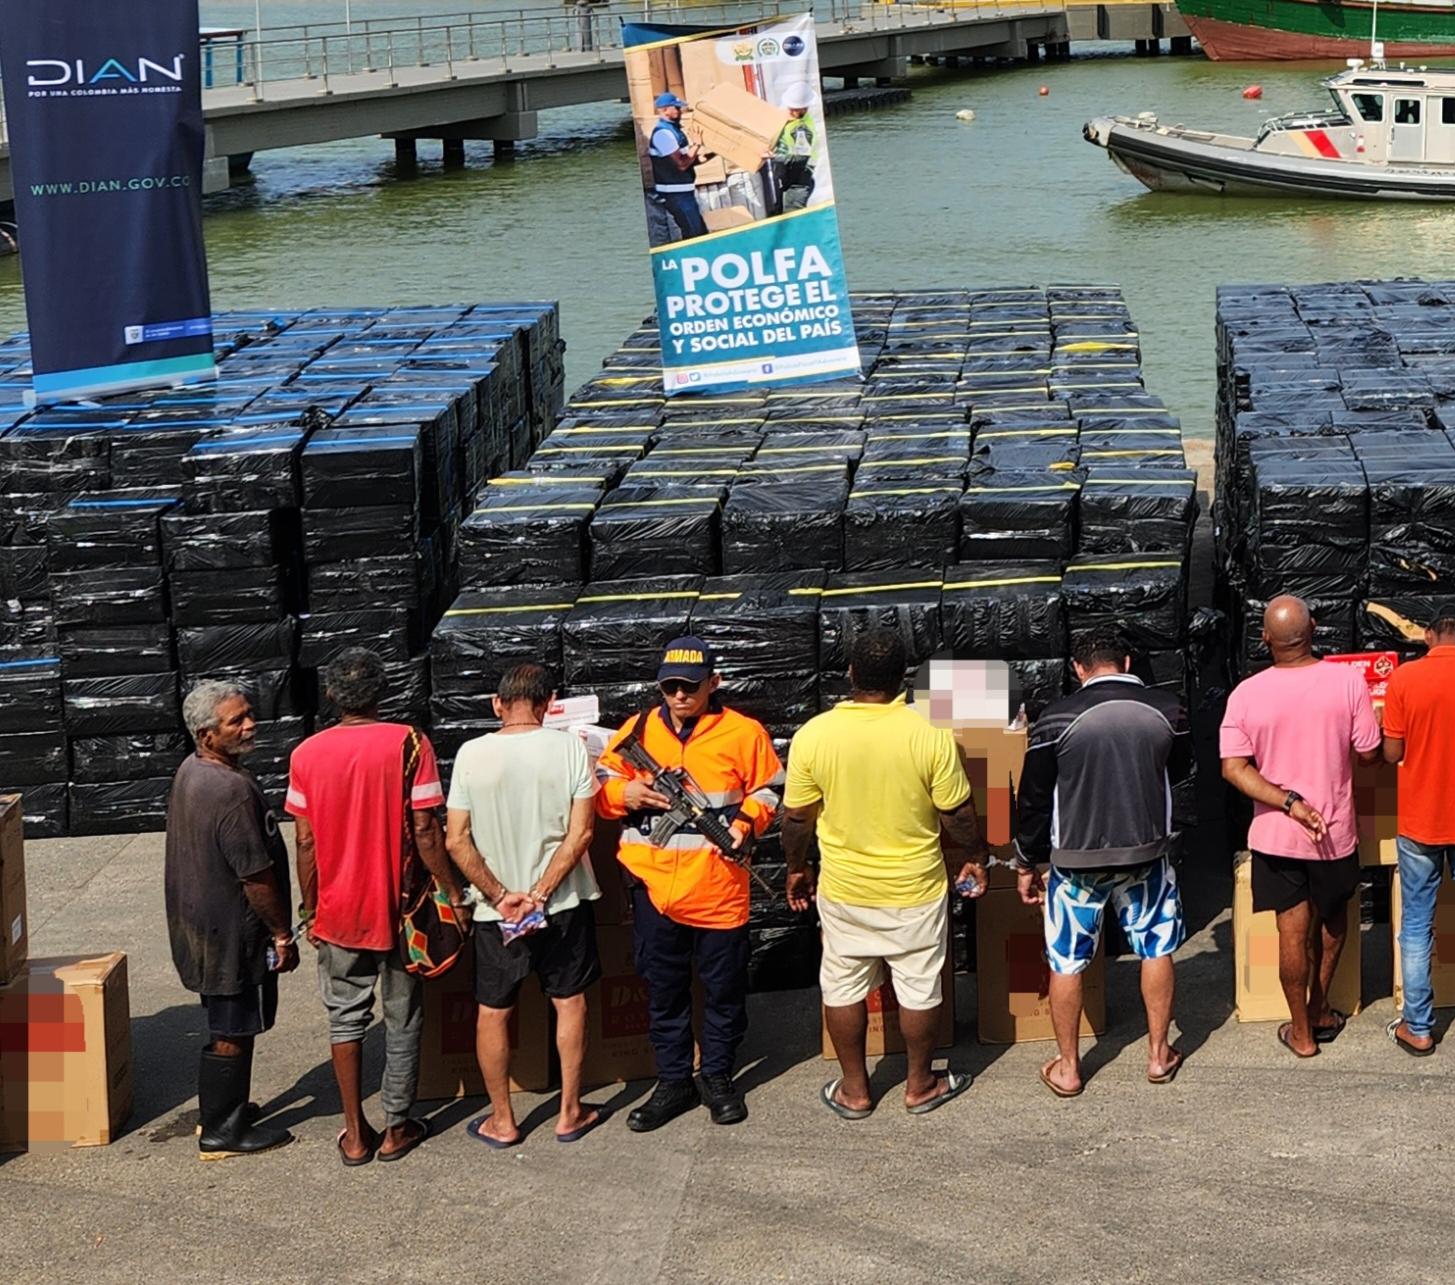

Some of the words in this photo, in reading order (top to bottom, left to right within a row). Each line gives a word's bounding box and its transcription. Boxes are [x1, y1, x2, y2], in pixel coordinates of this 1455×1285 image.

[71, 88, 118, 96] COLOMBIA
[30, 175, 191, 196] WWW.DIAN.GOV.CO
[662, 258, 678, 271] LA
[681, 245, 833, 293] POLFA
[666, 283, 801, 319] PROTEGE
[804, 280, 837, 304] EL
[669, 317, 729, 337] ORDEN
[733, 304, 839, 330] ECONÓMICO
[672, 339, 685, 354] Y
[690, 331, 759, 353] SOCIAL
[763, 326, 797, 345] DEL
[800, 318, 842, 339] PAÍS
[664, 648, 704, 664] ARMADA
